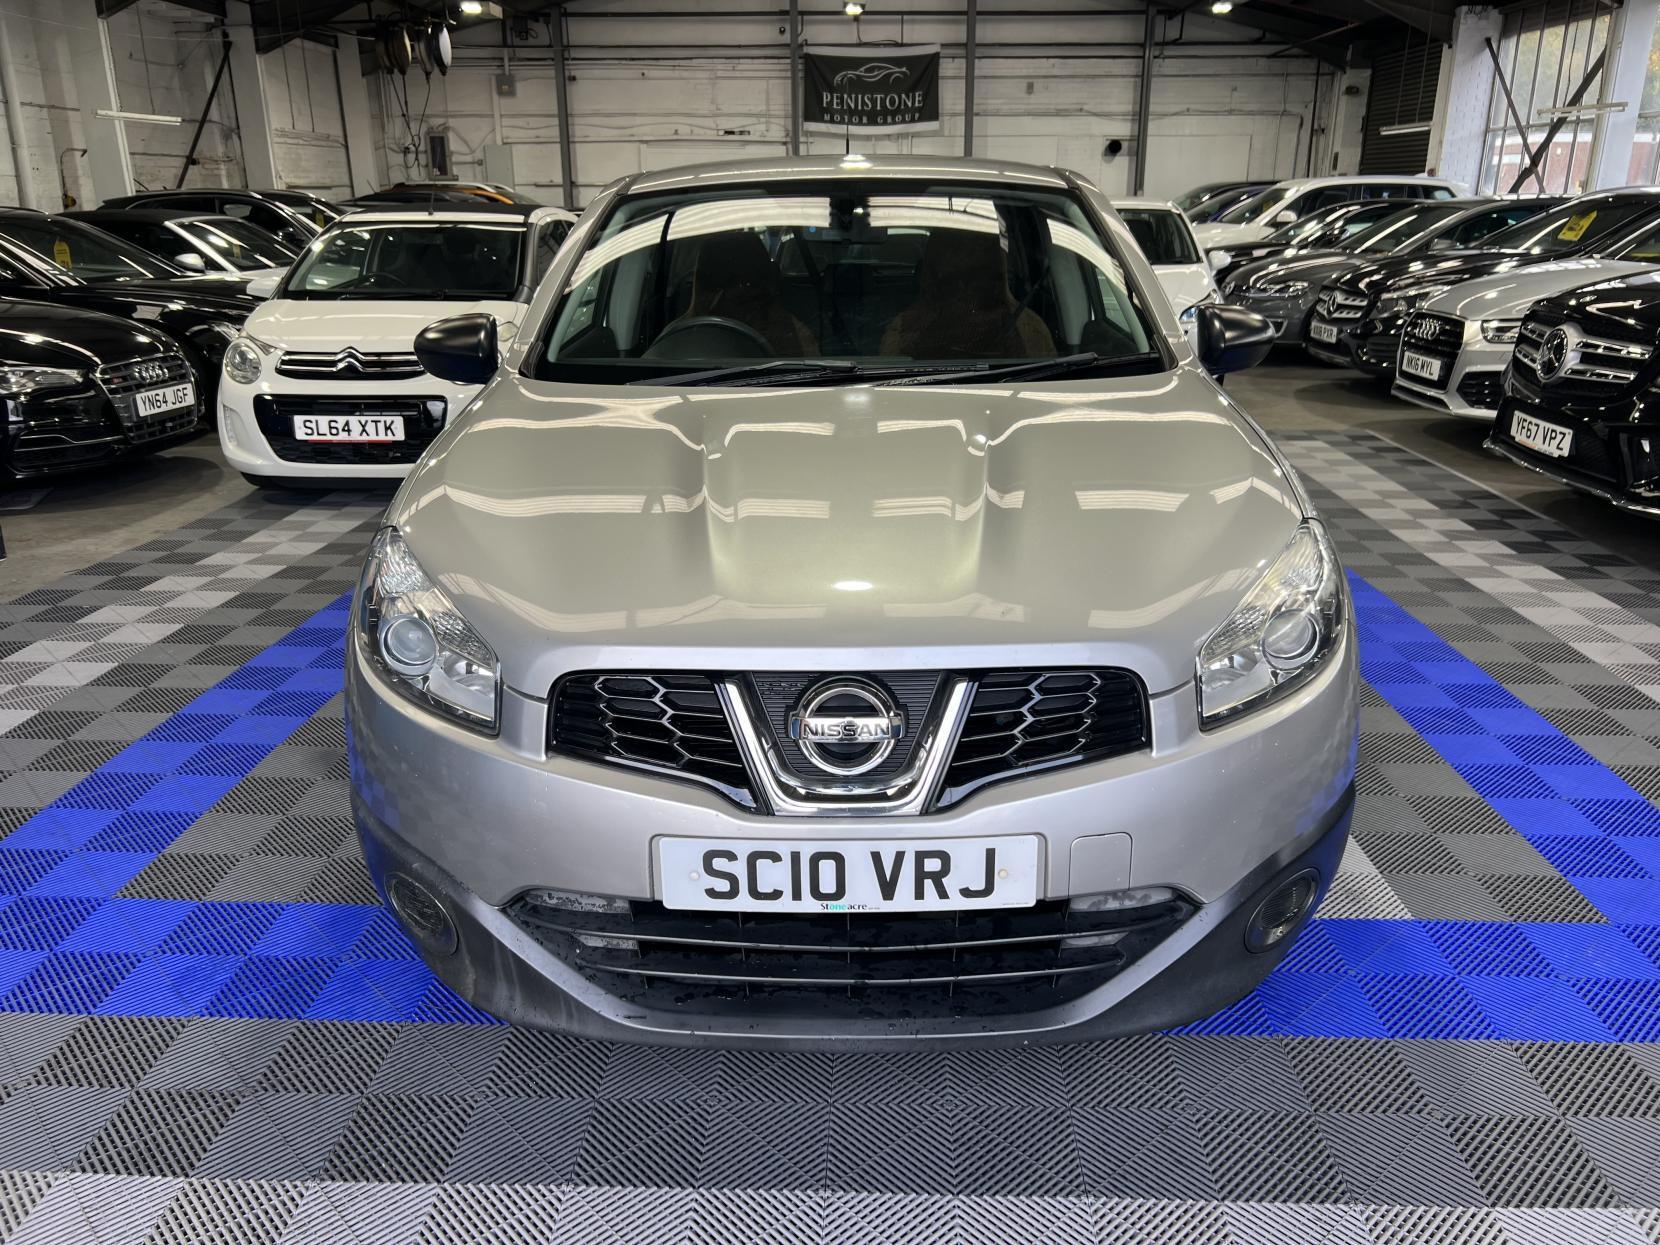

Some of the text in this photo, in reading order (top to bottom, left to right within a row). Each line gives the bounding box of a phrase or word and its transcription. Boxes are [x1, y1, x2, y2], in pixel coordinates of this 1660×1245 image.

[822, 91, 923, 110] PENISTONE
[824, 113, 920, 123] MOTOR GROUP
[1420, 359, 1434, 376] MYL
[140, 387, 188, 411] YN64 JGF
[303, 420, 395, 436] SL64 XTK
[1516, 415, 1567, 451] YF67 VPZ
[803, 723, 890, 738] NISSAN
[702, 848, 996, 901] SC10 VRJ
